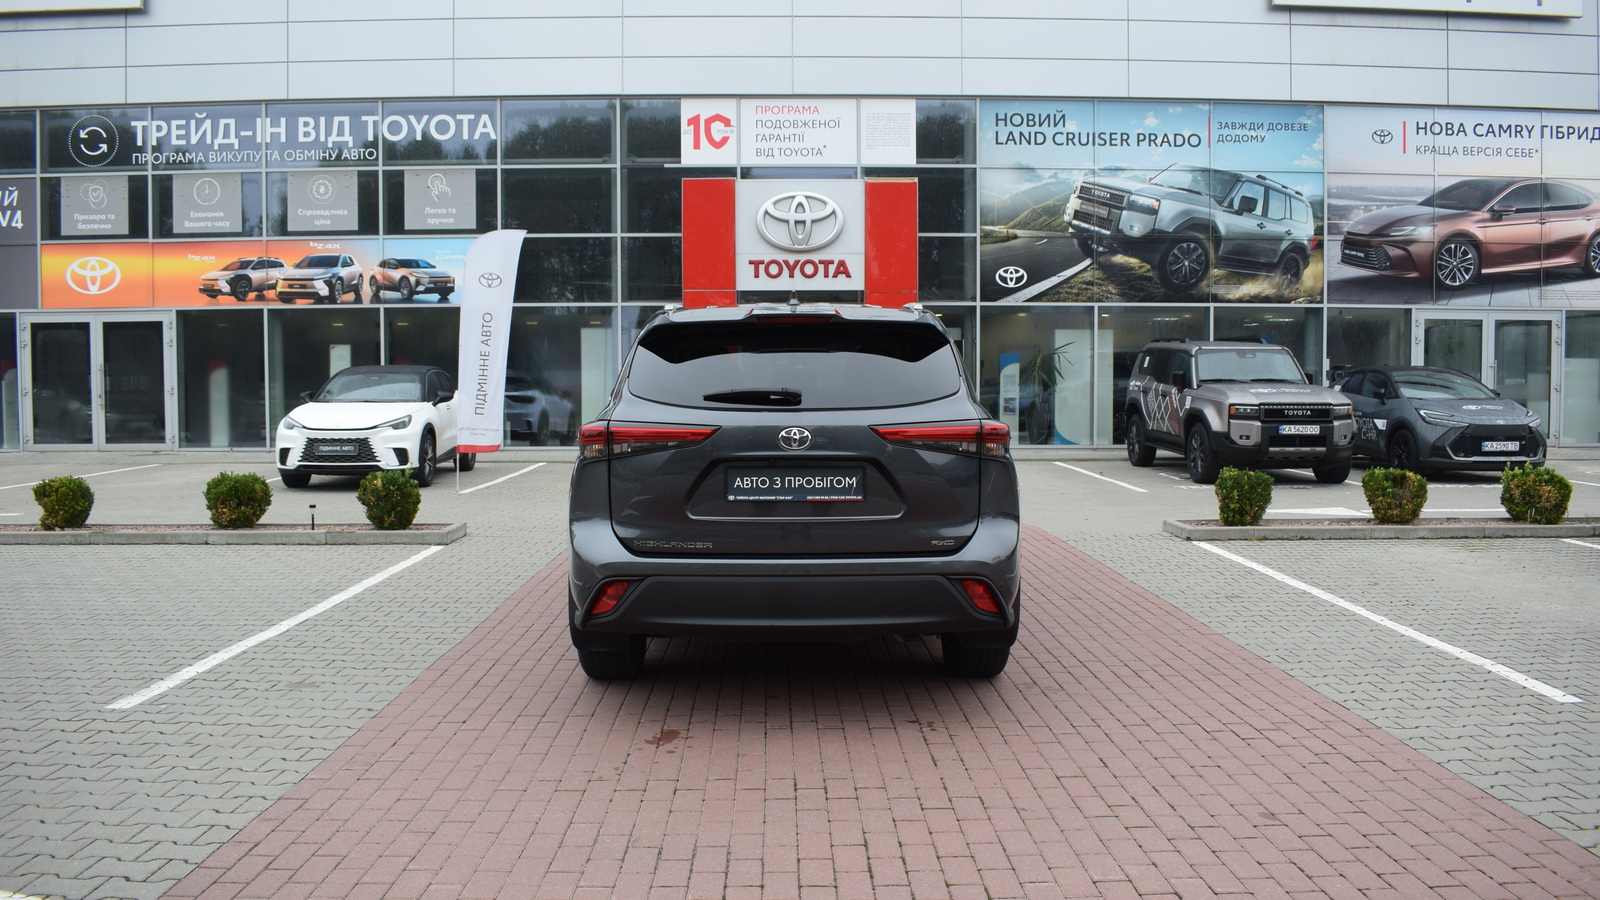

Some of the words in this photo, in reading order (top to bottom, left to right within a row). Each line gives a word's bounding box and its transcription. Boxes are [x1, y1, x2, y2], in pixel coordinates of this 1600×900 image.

[755, 105, 820, 115] ПРОГРАМА
[755, 117, 842, 130] ПОДОВЖЕНОЇ
[995, 109, 1066, 128] НОВИЙ
[131, 112, 286, 150] ТРЕЙД-ІН
[298, 116, 354, 148] ВІД
[361, 113, 498, 142] TOYOTA
[1216, 121, 1264, 132] ЗАВЖДИ
[1266, 122, 1309, 133] ДОВЕЗЕ
[1415, 121, 1468, 137] НОВА
[1473, 122, 1535, 139] CAMRY
[1541, 124, 1600, 144] ГІБРИД
[755, 131, 806, 143] ГАРАНТІЇ
[995, 130, 1047, 146] LAND
[1052, 131, 1131, 147] CRUISER
[1136, 132, 1202, 148] PRADO
[1216, 134, 1266, 144] ДОДОМУ
[132, 151, 206, 165] ПРОГРАМА
[208, 150, 262, 164] ВИКУПУ
[265, 149, 281, 161] ТА
[284, 148, 339, 161] ОБМІНУ
[341, 147, 377, 161] АВТО
[755, 147, 775, 159] ВІД
[1415, 145, 1459, 157] КРАЩА
[1462, 146, 1502, 157] ВЕРСІЯ
[1091, 189, 1110, 198] TOYOTA
[190, 210, 224, 218] Економія
[297, 208, 348, 217] Справедлива
[424, 206, 446, 214] Легко
[74, 213, 107, 222] Прозоро
[314, 217, 331, 226] ціна
[426, 217, 455, 225] зручно
[77, 222, 112, 230] безпечно
[184, 220, 211, 228] Вашого
[213, 220, 231, 229] часу
[748, 259, 852, 279] TOYOTA
[480, 312, 494, 348] АВТО
[474, 350, 491, 416] ПІДМІННЕ
[1282, 425, 1293, 433] KA
[1293, 425, 1309, 433] 5620
[1353, 417, 1375, 429] OYOTA
[1485, 442, 1494, 450] KA
[733, 476, 770, 489] АВТО
[772, 476, 782, 488] З
[785, 476, 857, 488] ПРОБІГОМ
[634, 540, 713, 549] HIGHLANDER
